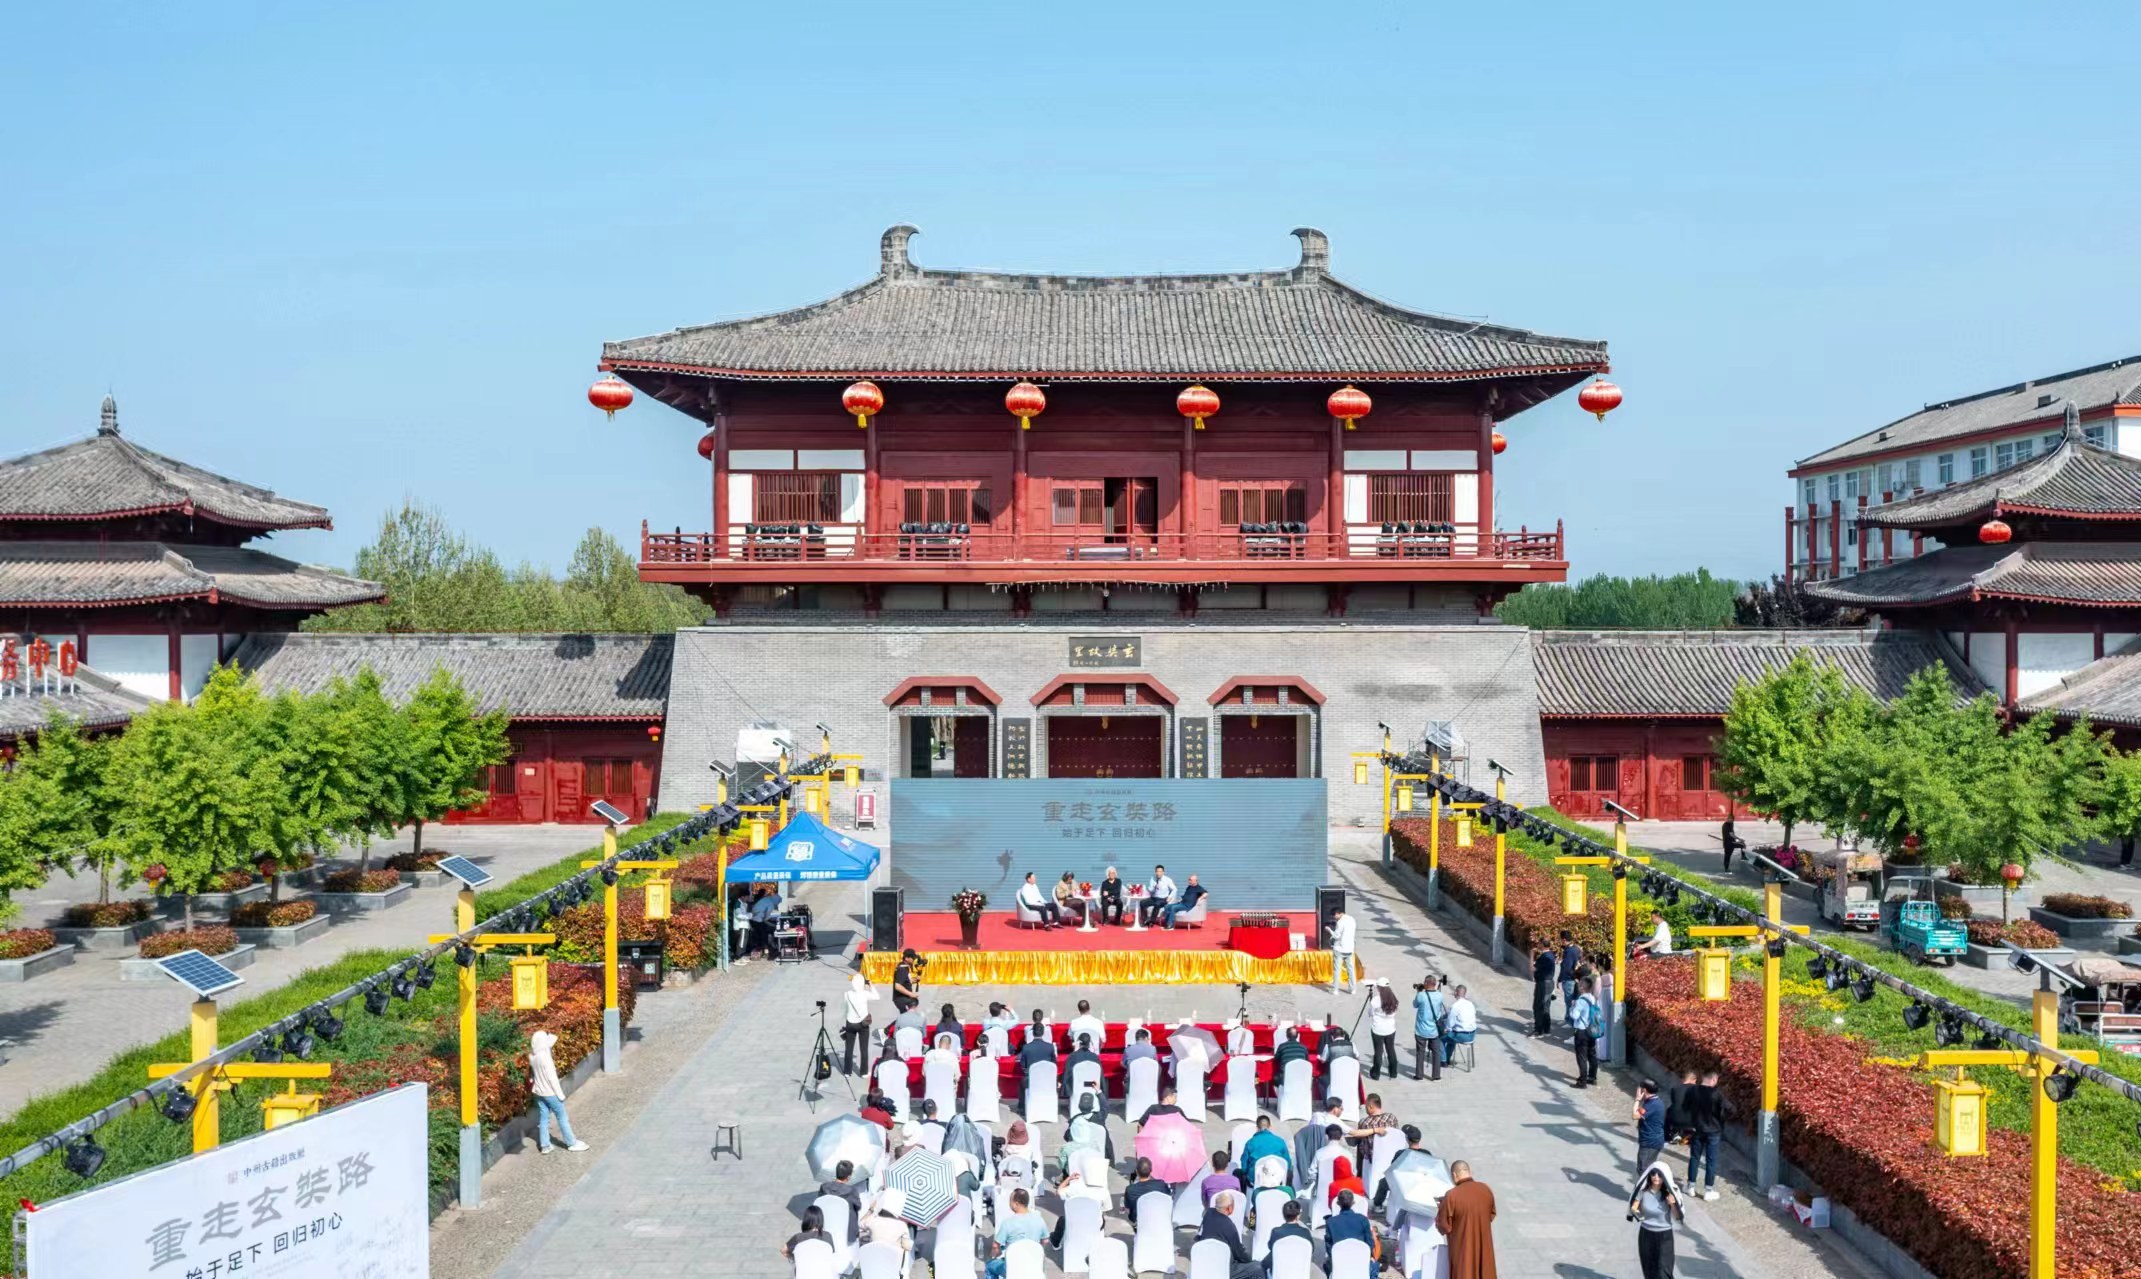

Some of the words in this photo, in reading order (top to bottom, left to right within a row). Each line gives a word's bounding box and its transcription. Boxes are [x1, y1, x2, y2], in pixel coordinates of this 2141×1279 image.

[1041, 801, 1177, 822] 重走玄奘路
[1062, 828, 1106, 838] 始于足下
[1112, 828, 1154, 838] 回归初心
[145, 1152, 375, 1271] 重走玄奘路
[273, 1212, 343, 1254] 回归初心
